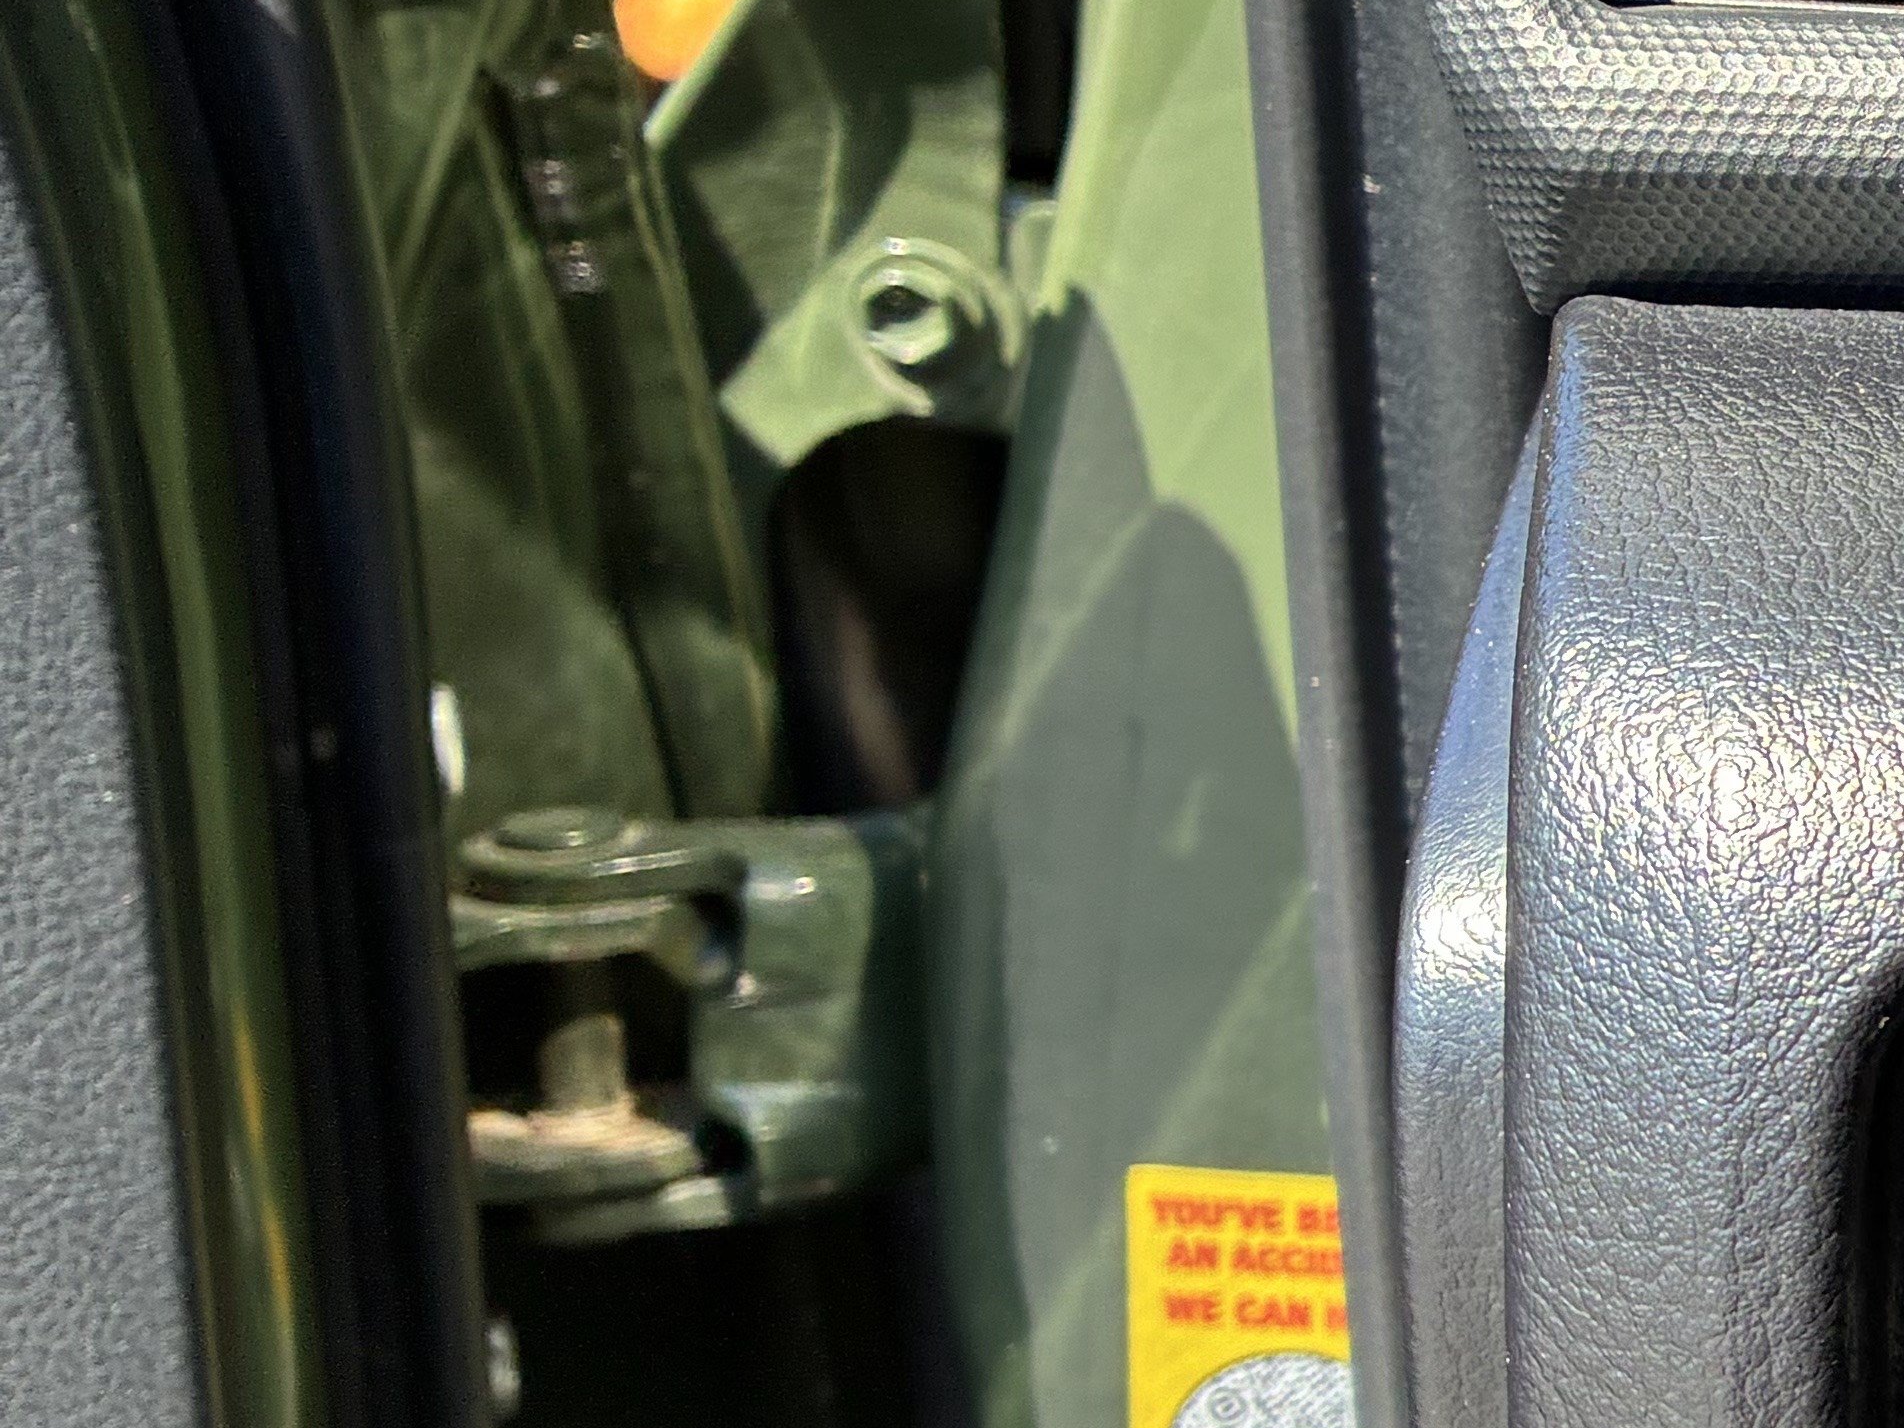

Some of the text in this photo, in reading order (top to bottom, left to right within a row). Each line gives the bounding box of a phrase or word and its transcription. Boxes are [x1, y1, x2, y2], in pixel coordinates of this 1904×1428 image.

[1151, 1196, 1282, 1234] YOU'VE
[1167, 1238, 1218, 1269] AN
[1164, 1292, 1222, 1325] WE
[1235, 1294, 1311, 1330] CAN
